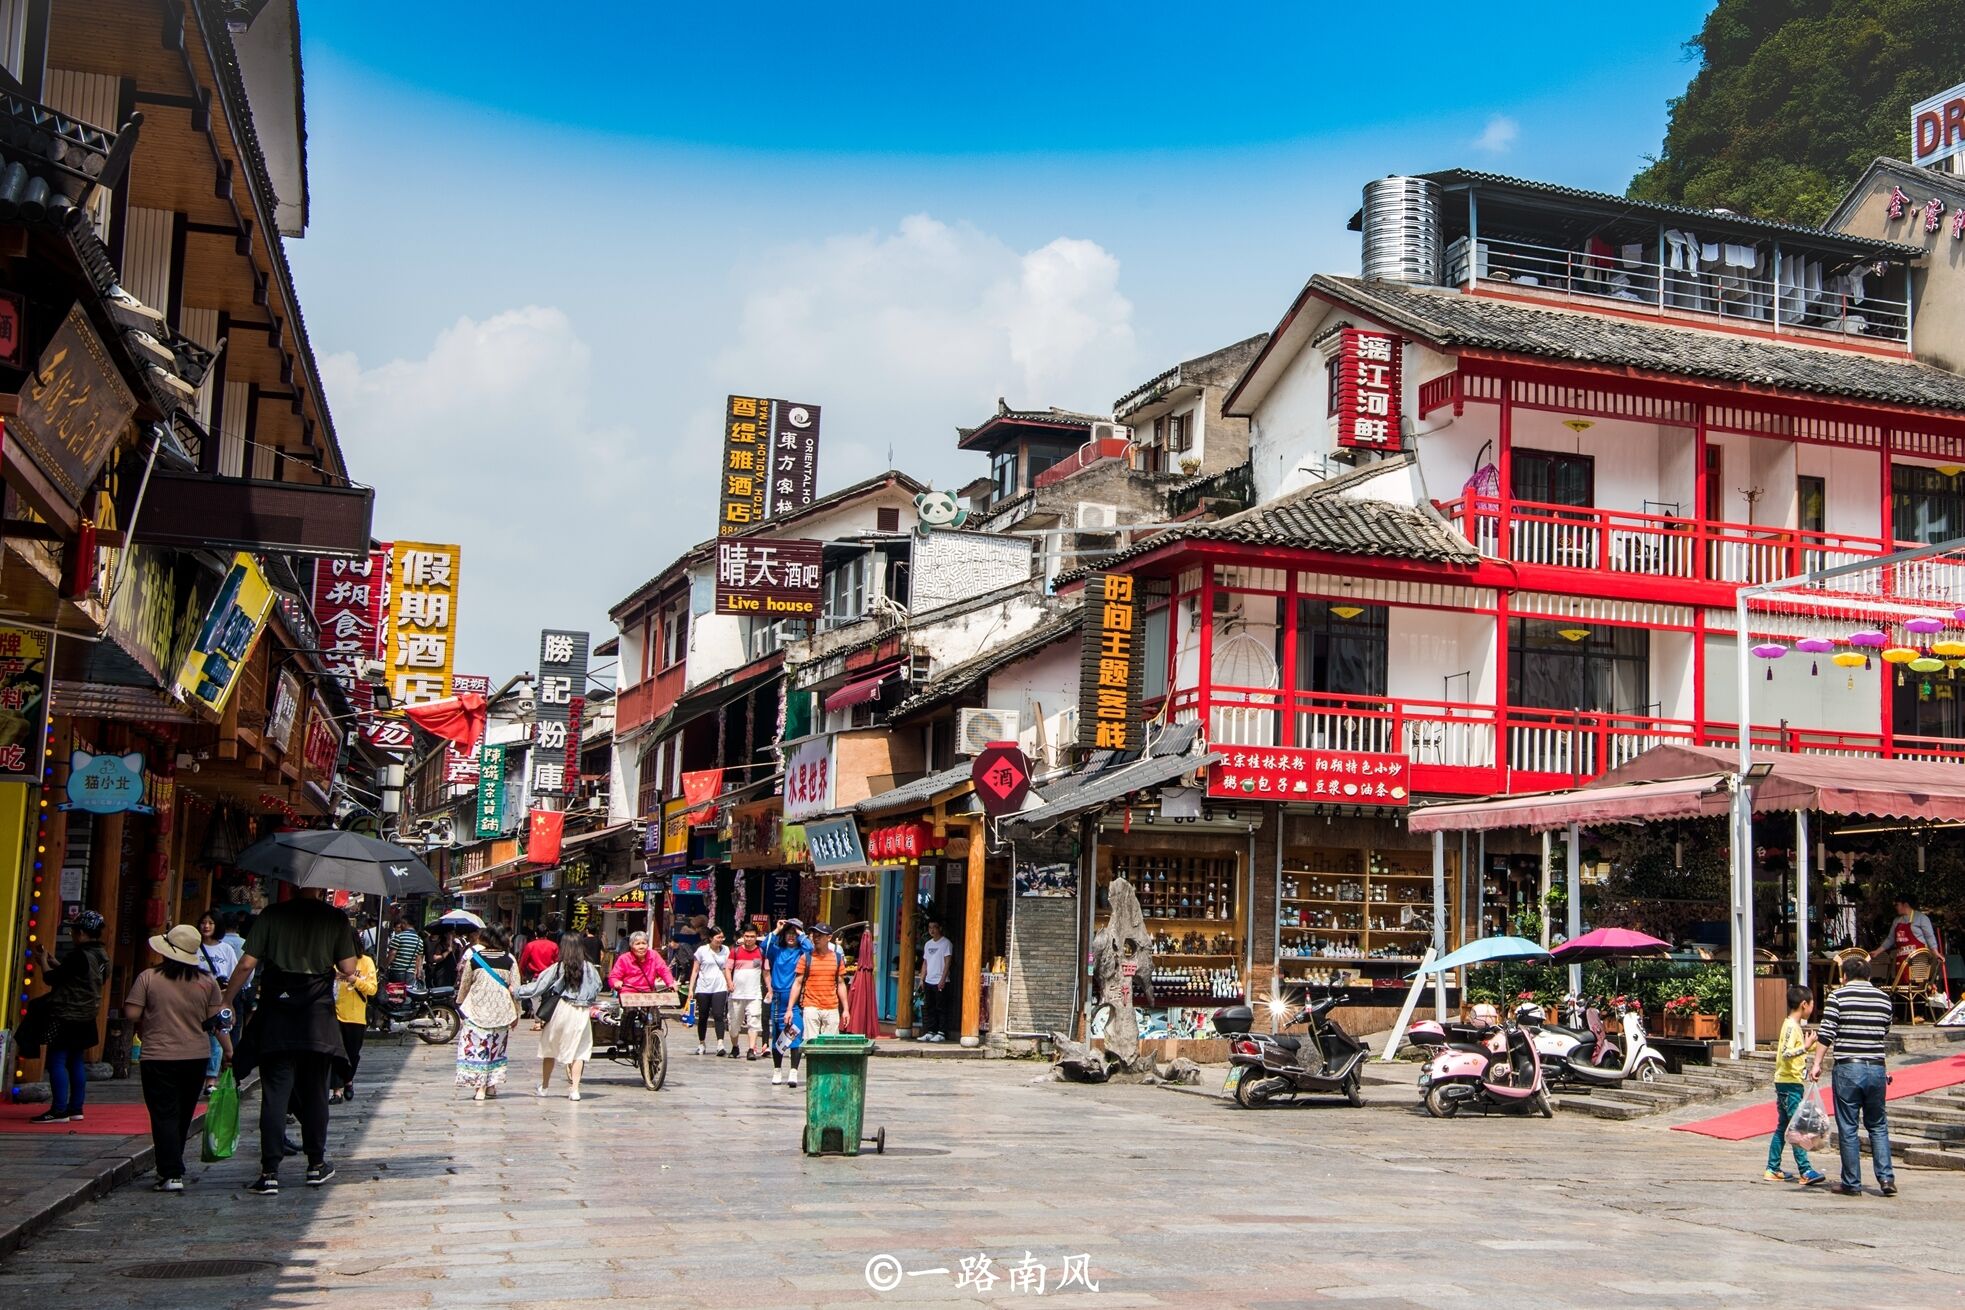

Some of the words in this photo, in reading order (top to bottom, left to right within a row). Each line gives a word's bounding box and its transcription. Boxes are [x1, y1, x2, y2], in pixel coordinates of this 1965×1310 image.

[1355, 334, 1391, 443] 漓江河鲜
[727, 397, 756, 523] 香缇雅酒店
[803, 438, 814, 488] ORIENTAL
[393, 549, 451, 707] 假期酒店
[728, 595, 760, 610] Live
[767, 597, 814, 612] house
[1096, 574, 1134, 749] 时间主题客栈
[534, 634, 573, 792] 勝記粉庫
[567, 696, 585, 729] Rice
[84, 774, 131, 791] 猫小北
[562, 732, 583, 794] noodles
[788, 756, 828, 807] 水果世界
[992, 767, 1014, 788] 酒
[1218, 751, 1306, 772] 正宗桂林米粉
[1315, 757, 1403, 777] 阳朔特色小炒
[1313, 778, 1342, 796] 豆浆
[1360, 782, 1389, 798] 油条
